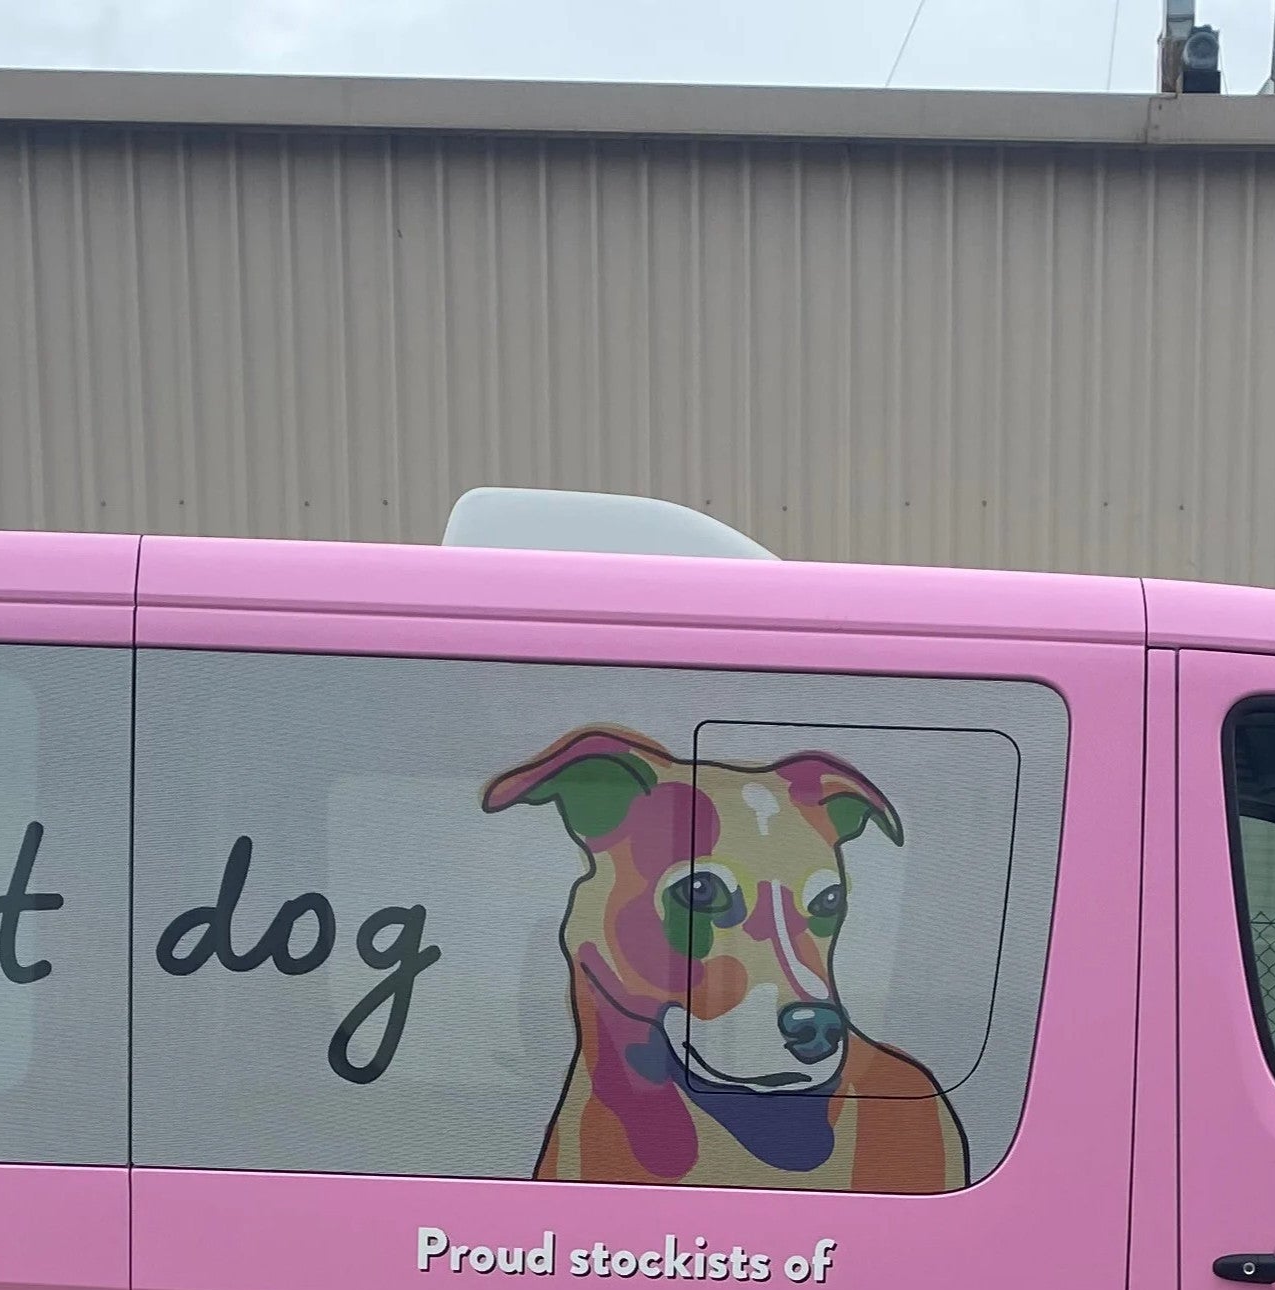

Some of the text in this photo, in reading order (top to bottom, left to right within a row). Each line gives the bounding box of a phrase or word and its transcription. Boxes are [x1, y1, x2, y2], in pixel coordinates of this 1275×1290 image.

[155, 835, 442, 1086] dog
[417, 1227, 837, 1283] Proud stockists of
